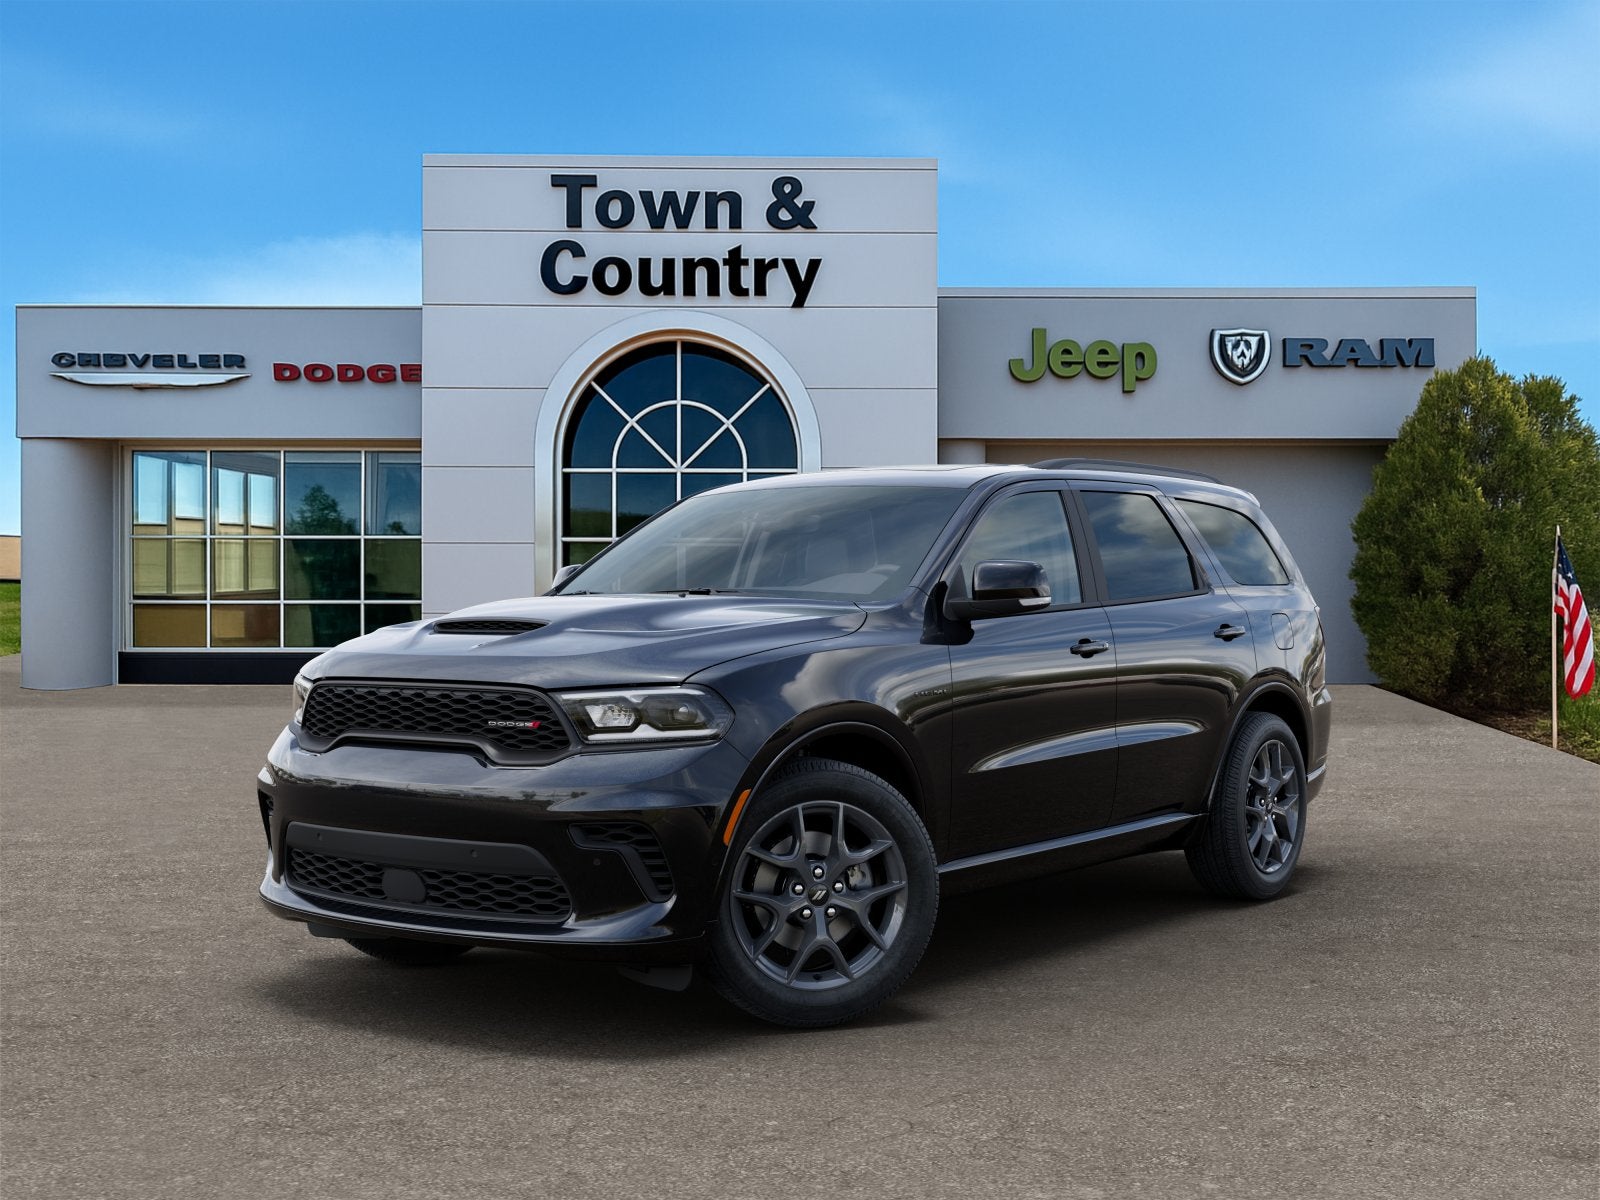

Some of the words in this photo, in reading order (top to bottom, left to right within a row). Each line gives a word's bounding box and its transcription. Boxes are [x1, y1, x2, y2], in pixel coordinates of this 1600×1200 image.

[550, 174, 742, 229] Town
[765, 176, 818, 230] &
[540, 239, 822, 308] Country
[273, 362, 422, 383] DODGE
[1009, 328, 1157, 392] Jeep
[1282, 337, 1436, 368] RAM
